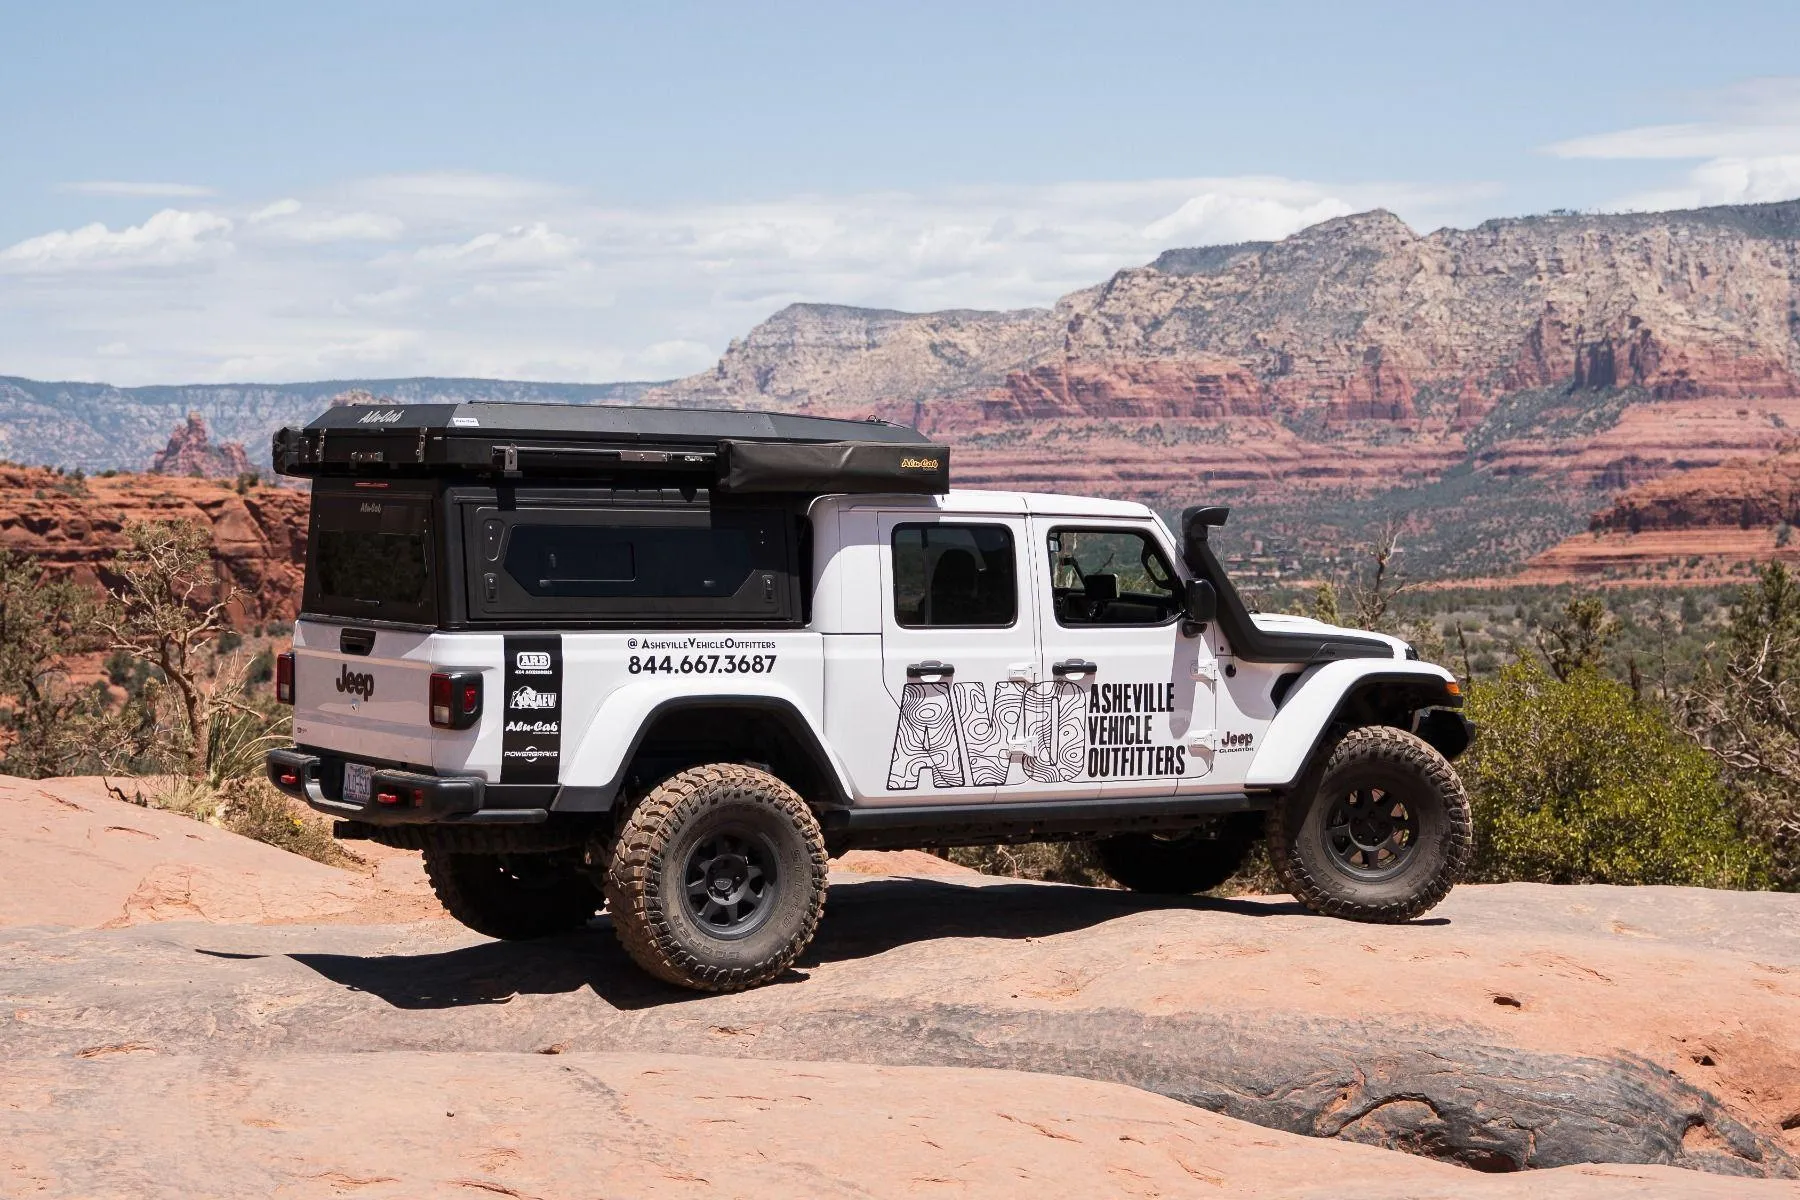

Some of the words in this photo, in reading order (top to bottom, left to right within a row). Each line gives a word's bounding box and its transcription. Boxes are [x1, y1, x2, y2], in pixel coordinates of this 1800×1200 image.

[627, 637, 638, 649] @
[520, 655, 548, 666] ARB
[628, 654, 777, 675] 844.667.3687
[336, 663, 375, 702] Jeep
[535, 693, 555, 707] AEV
[1088, 682, 1175, 713] ASHEVILLE
[505, 721, 558, 732] Alu-Cab
[1088, 715, 1152, 746] VEHICLE
[1221, 731, 1254, 747] Jeep
[1087, 746, 1186, 778] OUTFITTERS
